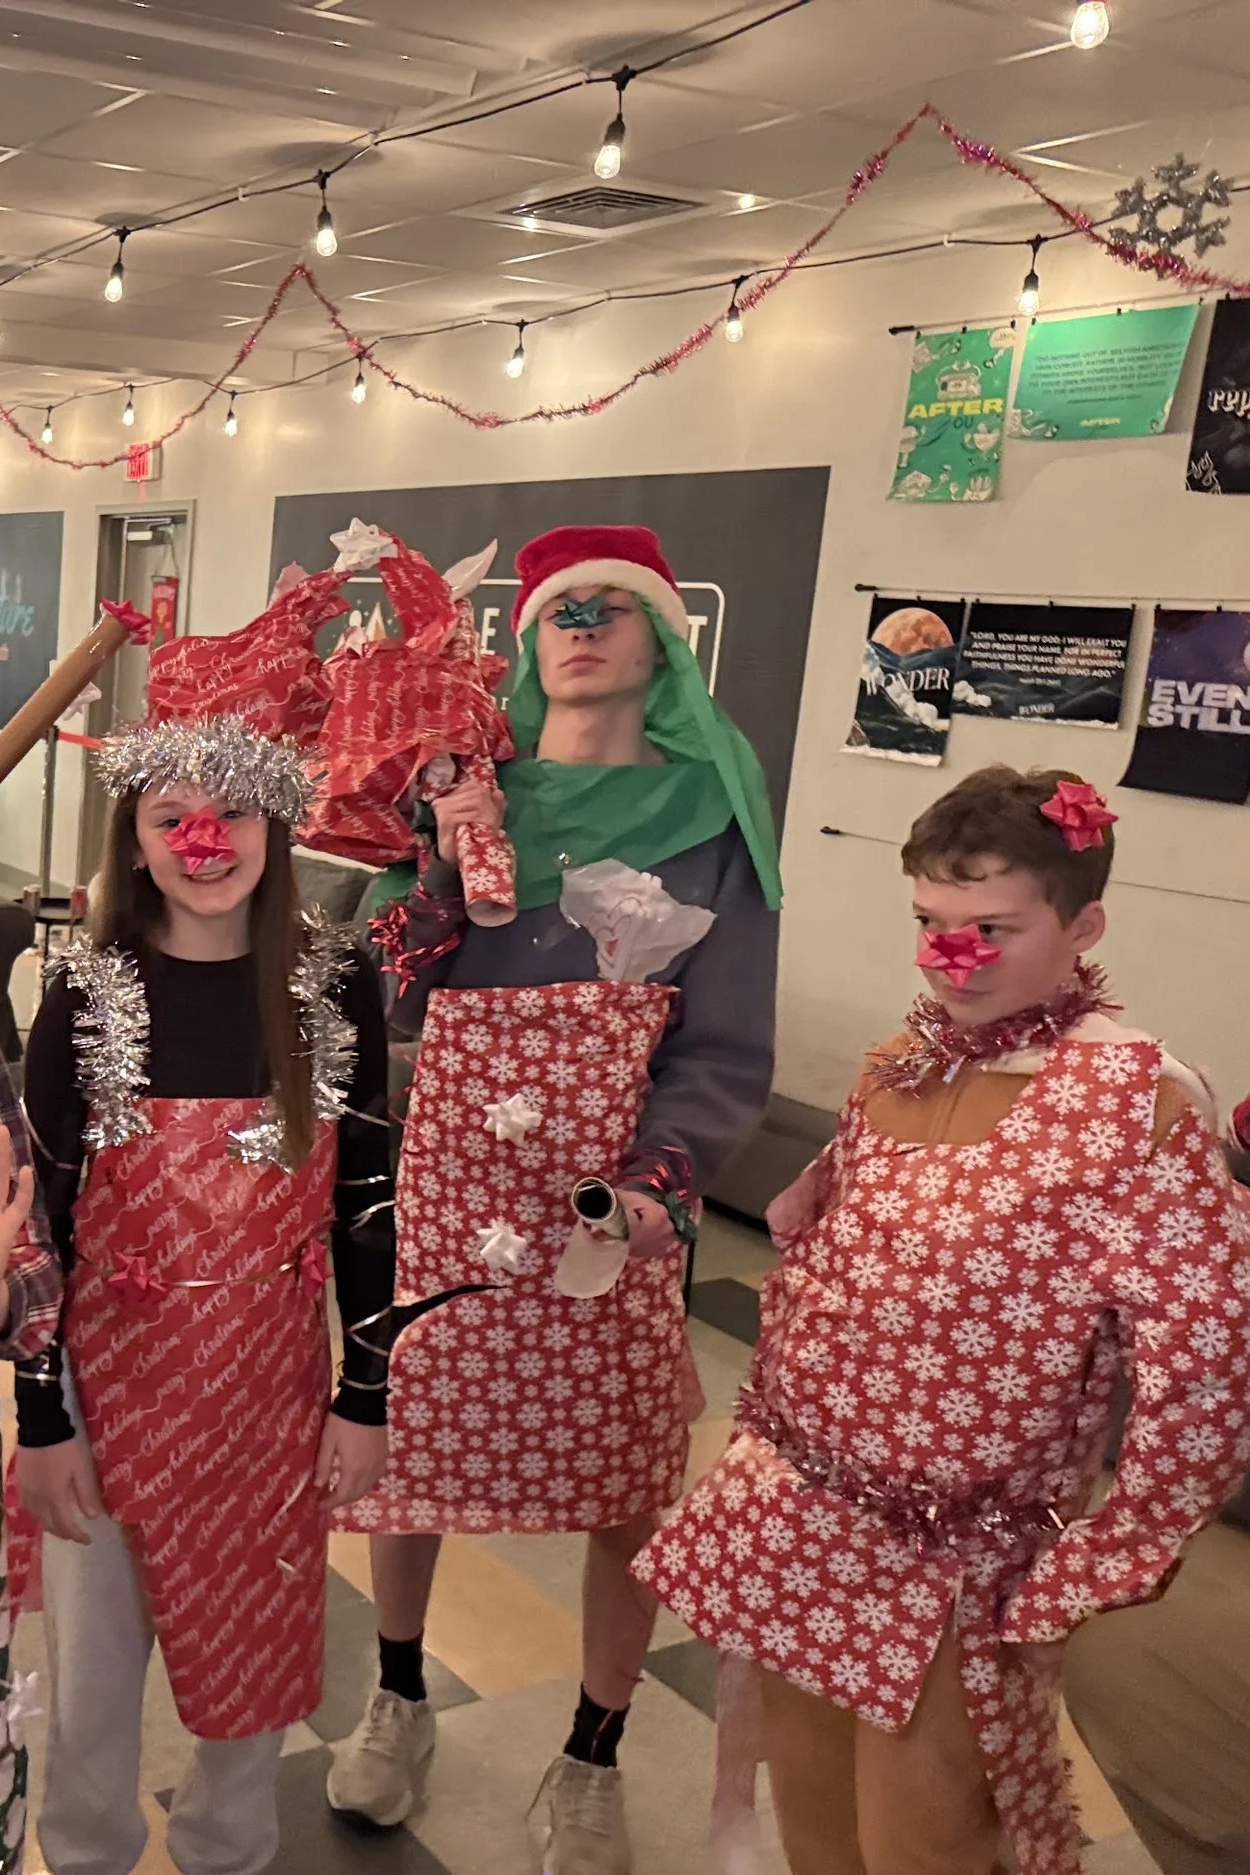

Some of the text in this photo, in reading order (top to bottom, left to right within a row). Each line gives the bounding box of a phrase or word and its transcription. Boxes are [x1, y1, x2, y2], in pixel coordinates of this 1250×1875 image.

[908, 397, 1004, 419] AFTER
[972, 641, 991, 650] AND
[991, 642, 1016, 651] PRAISE
[1017, 644, 1038, 652] YOUR
[1064, 647, 1080, 655] FOR
[1080, 648, 1090, 656] IN
[1091, 649, 1123, 658] PERFECT
[997, 633, 1014, 641] YOU
[1015, 634, 1029, 642] ARE
[1029, 635, 1041, 643] MY
[1067, 637, 1085, 646] WILL
[1086, 638, 1109, 646] EXALT
[1110, 639, 1127, 648] YOU
[1017, 653, 1033, 662] YOU
[1054, 656, 1077, 665] DONE
[1078, 658, 1126, 669] WONDERFUL
[863, 666, 950, 696] WONDER
[1067, 668, 1090, 676] LONG
[1151, 679, 1250, 711] EVEN
[1147, 703, 1250, 734] STILL
